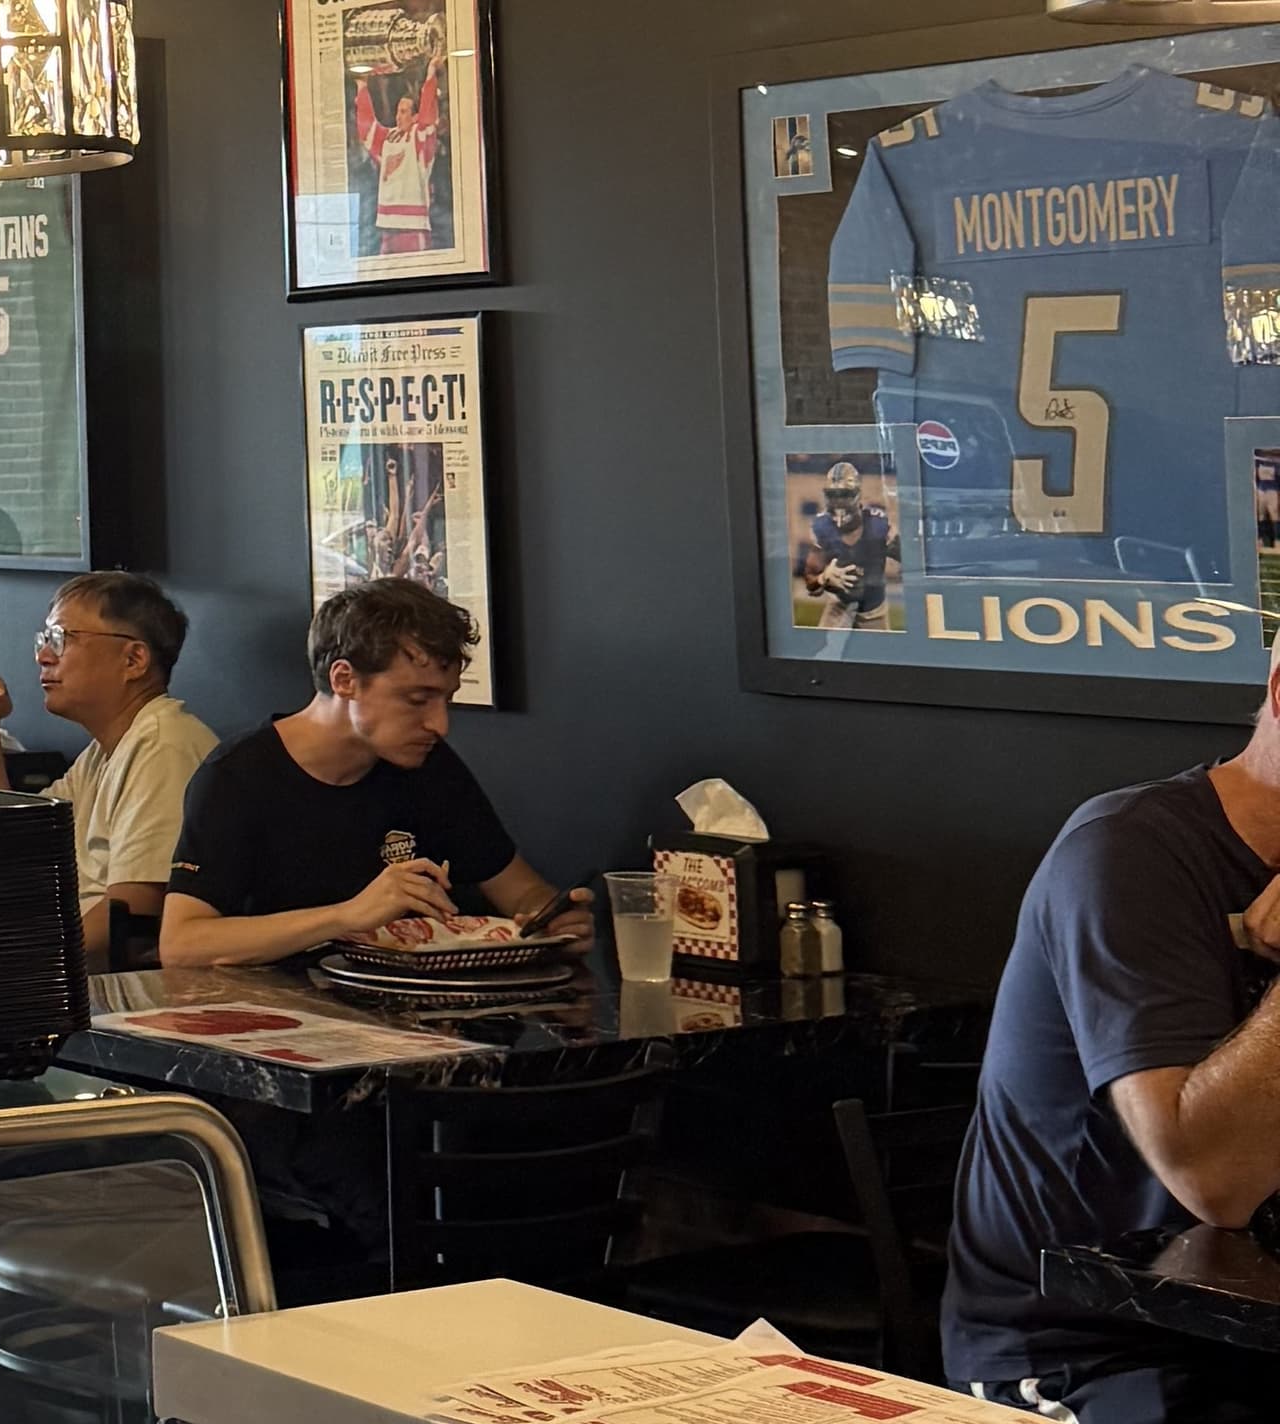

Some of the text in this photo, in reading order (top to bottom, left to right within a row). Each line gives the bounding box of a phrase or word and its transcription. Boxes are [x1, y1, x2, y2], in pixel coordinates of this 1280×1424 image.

[953, 173, 1180, 255] MONTGOMERY
[380, 344, 407, 363] Free
[410, 343, 446, 363] Press
[1010, 291, 1125, 536] 5
[924, 593, 1237, 653] LIONS
[683, 857, 704, 874] THE
